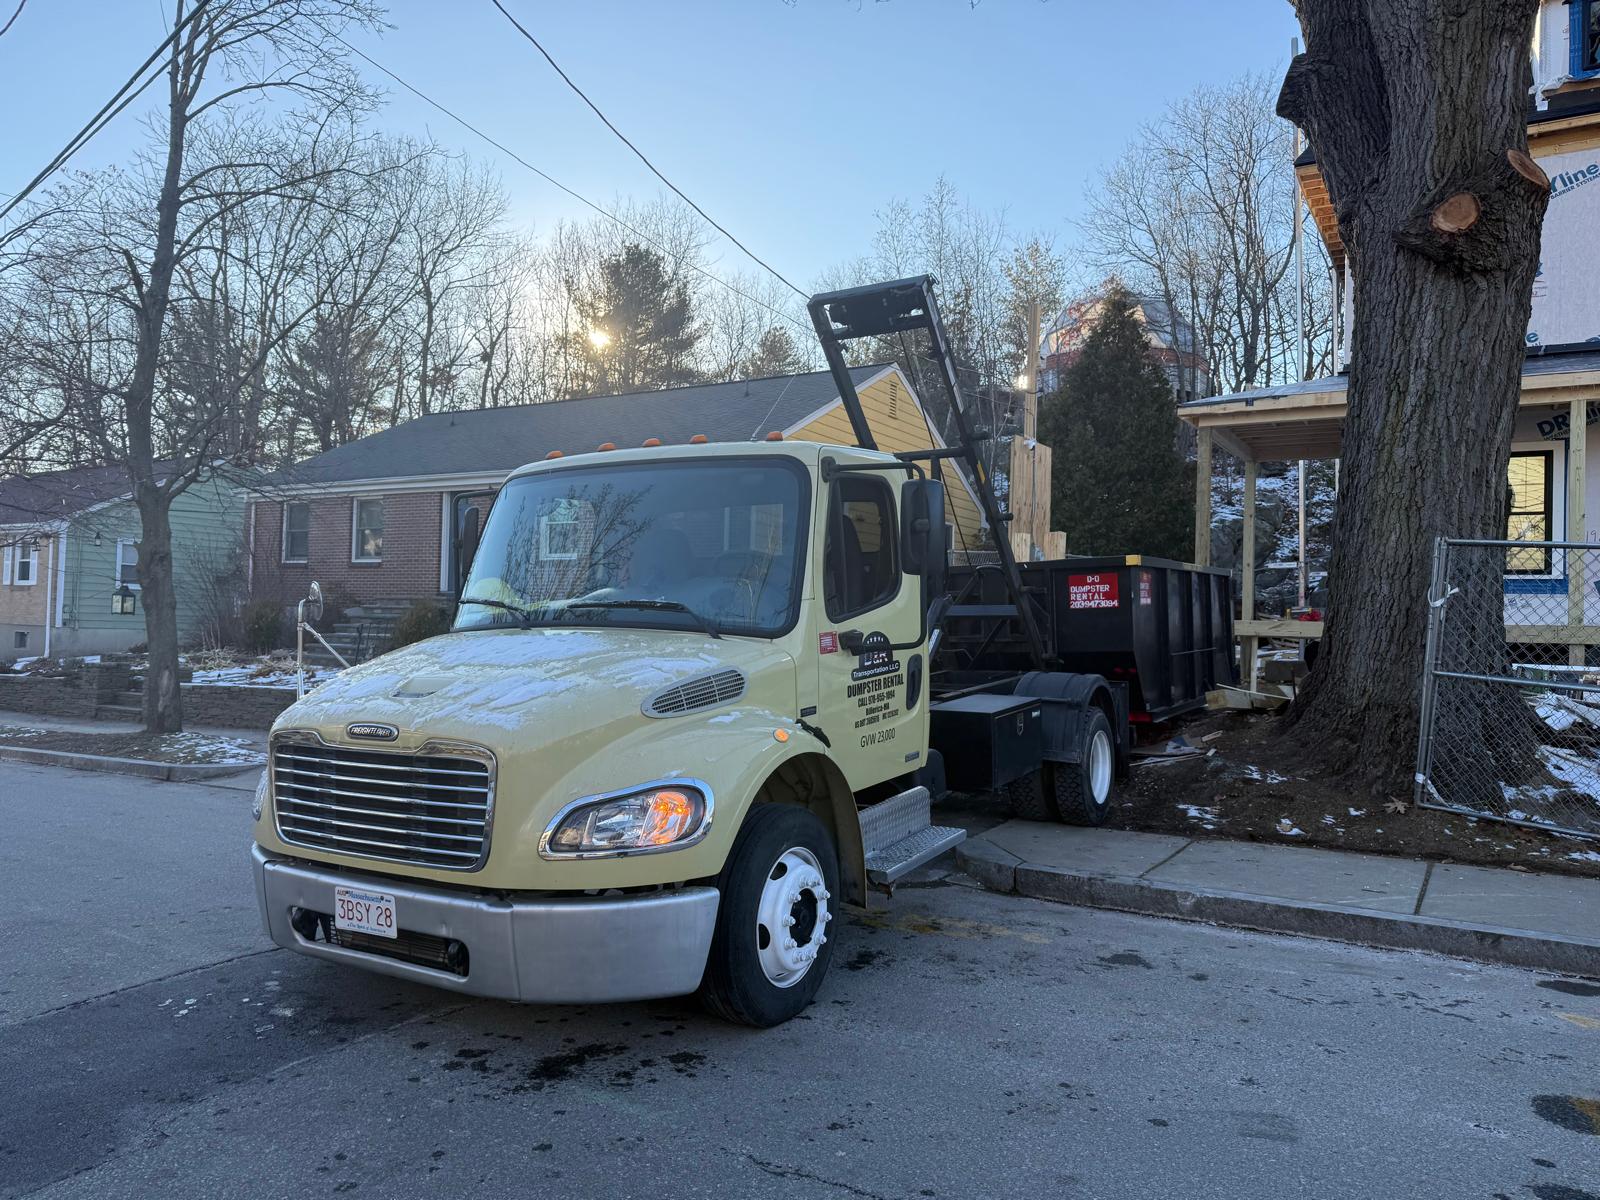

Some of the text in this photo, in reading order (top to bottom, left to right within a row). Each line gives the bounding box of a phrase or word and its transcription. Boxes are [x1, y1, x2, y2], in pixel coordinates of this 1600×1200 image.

[1575, 172, 1600, 187] SYSTEM
[1070, 584, 1110, 593] DUMPSTER
[1070, 592, 1105, 601] RENTAL
[853, 662, 899, 678] Transportation LLC
[847, 673, 904, 698] DUMPSTER RENTAL
[857, 697, 868, 708] CALL
[860, 728, 896, 748] GVW 23,000
[338, 898, 393, 928] 3BSY 28
